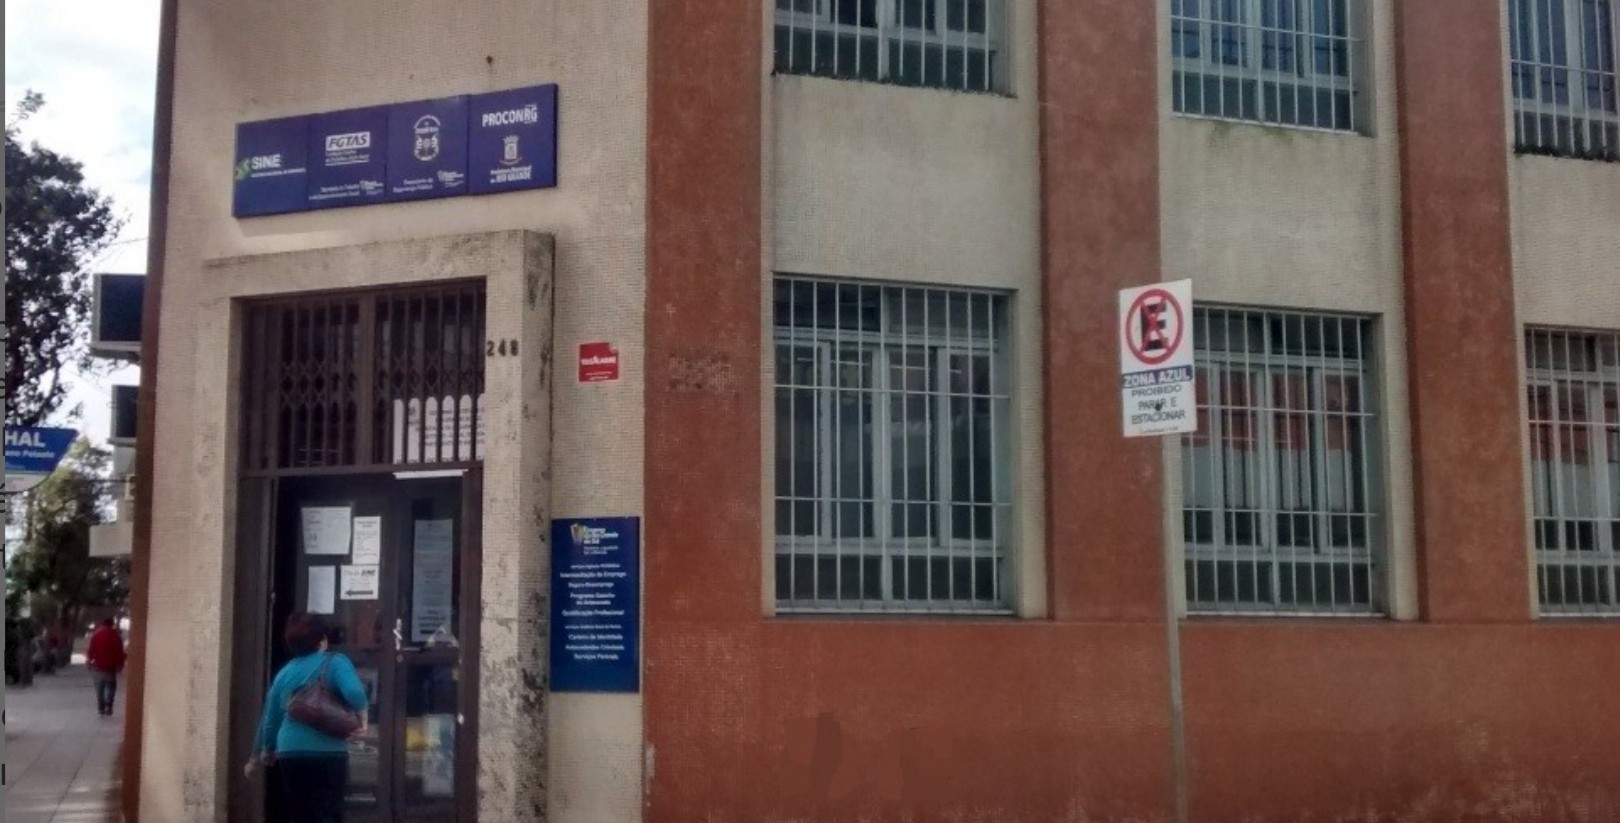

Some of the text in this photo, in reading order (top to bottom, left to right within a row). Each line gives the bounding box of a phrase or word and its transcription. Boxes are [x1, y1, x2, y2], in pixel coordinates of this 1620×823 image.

[328, 133, 368, 149] FGTAS
[251, 153, 281, 170] SINE
[1124, 368, 1190, 388] ZONA AZUL
[1131, 384, 1182, 397] PROIBIDO
[1138, 397, 1177, 411] PARAR E
[1131, 409, 1186, 424] ESTACIONAR
[5, 430, 46, 448] HAL
